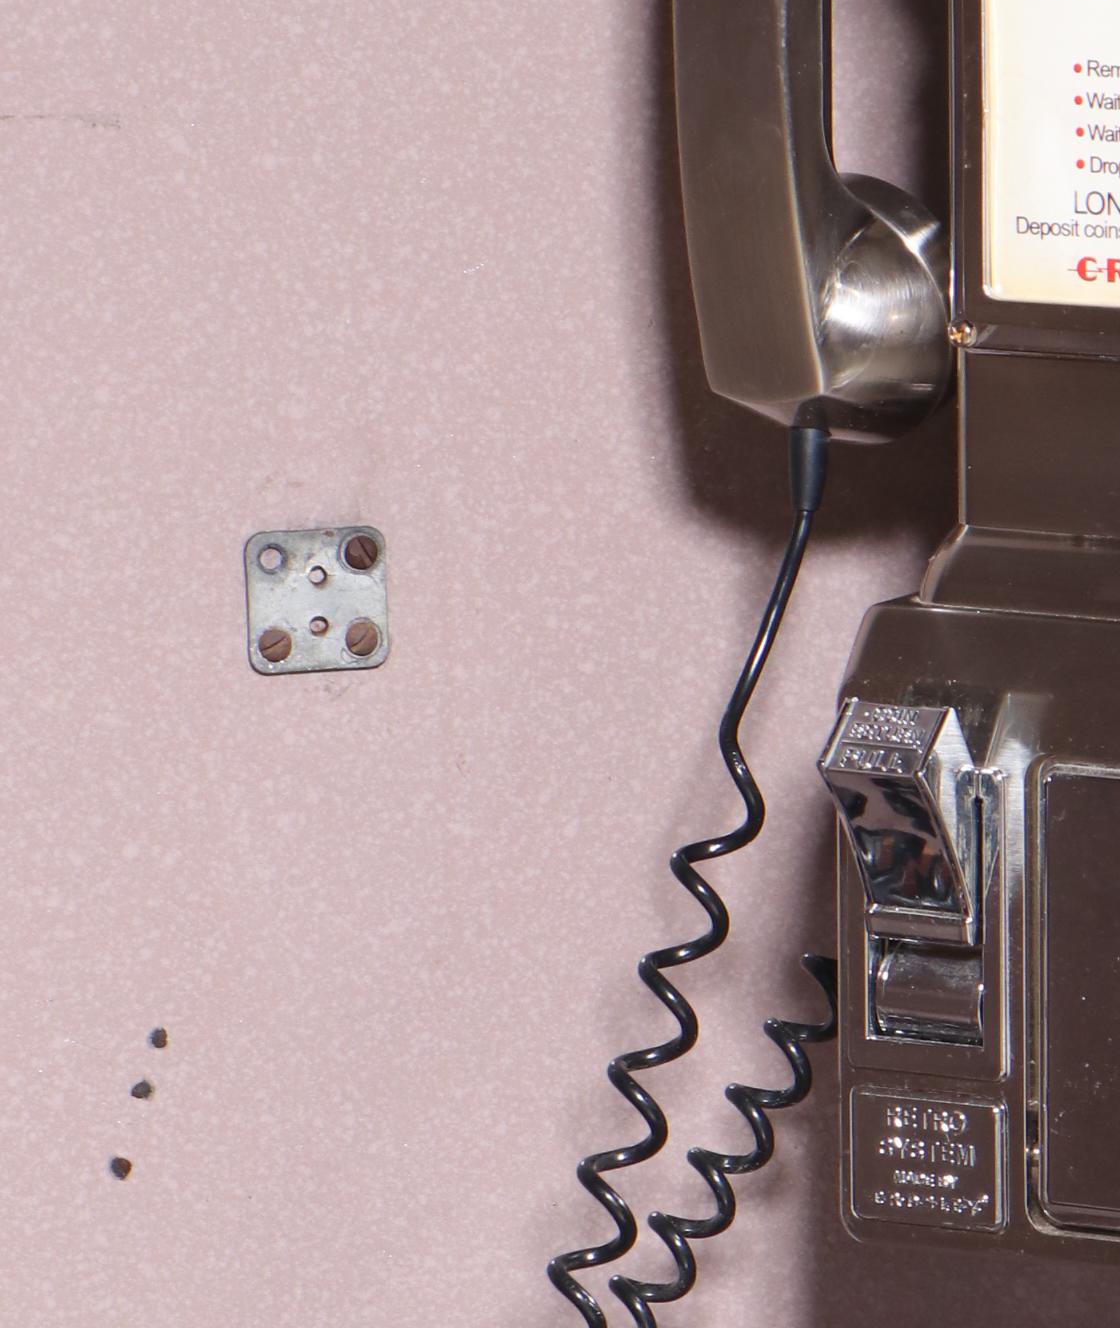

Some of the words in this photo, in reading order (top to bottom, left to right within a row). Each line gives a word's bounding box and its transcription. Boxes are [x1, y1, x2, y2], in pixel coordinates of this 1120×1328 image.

[1016, 216, 1079, 240] Deposit
[886, 1105, 968, 1136] RETRO
[878, 1135, 977, 1168] SYSTEM
